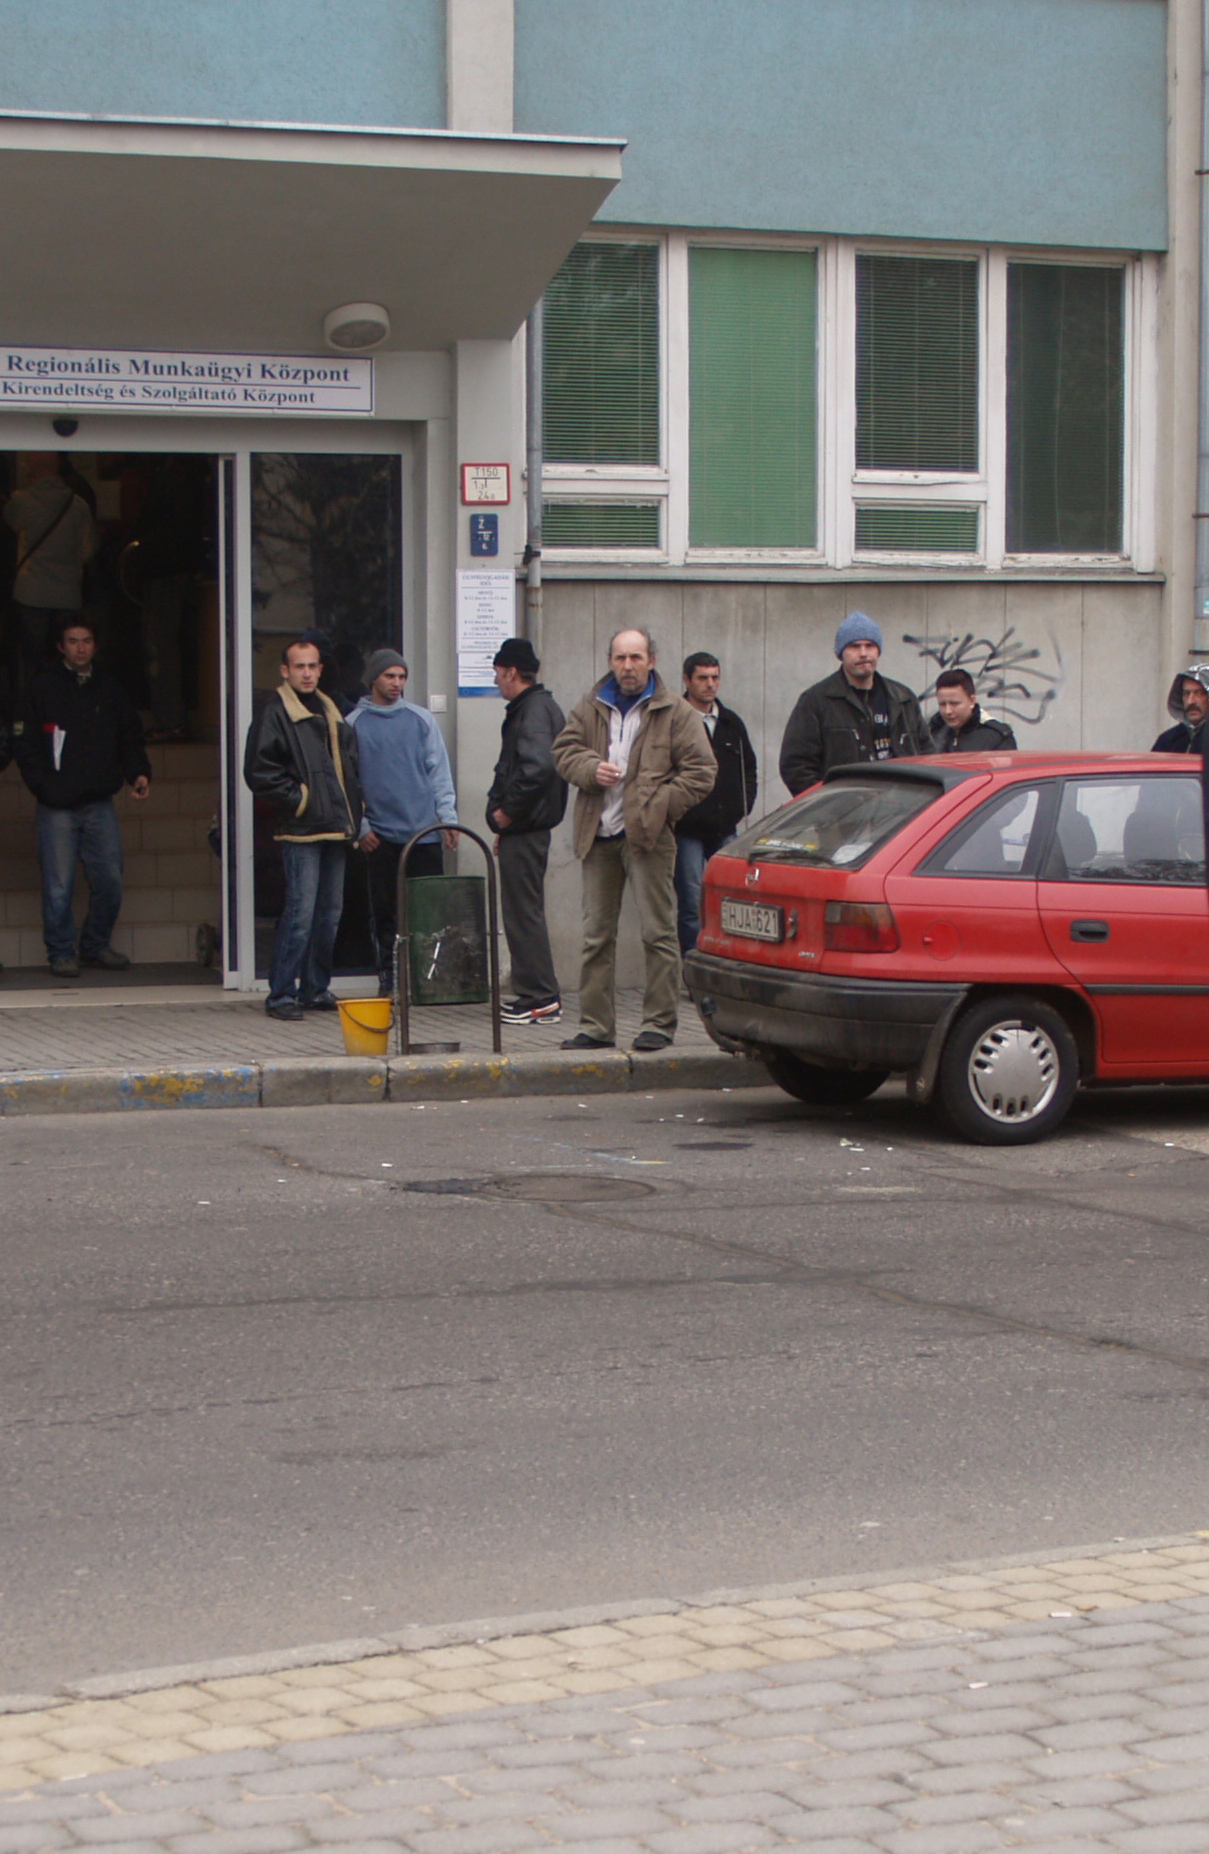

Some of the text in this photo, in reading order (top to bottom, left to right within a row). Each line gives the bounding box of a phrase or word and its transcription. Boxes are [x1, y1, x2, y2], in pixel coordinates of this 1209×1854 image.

[7, 354, 121, 377] Regionális
[128, 358, 252, 382] Munkaügyi
[260, 362, 351, 385] Központ
[2, 381, 114, 400] Kirendeltség
[119, 384, 136, 398] és
[141, 385, 237, 403] Szolgáltató
[243, 388, 316, 406] Központ
[474, 467, 499, 477] T150
